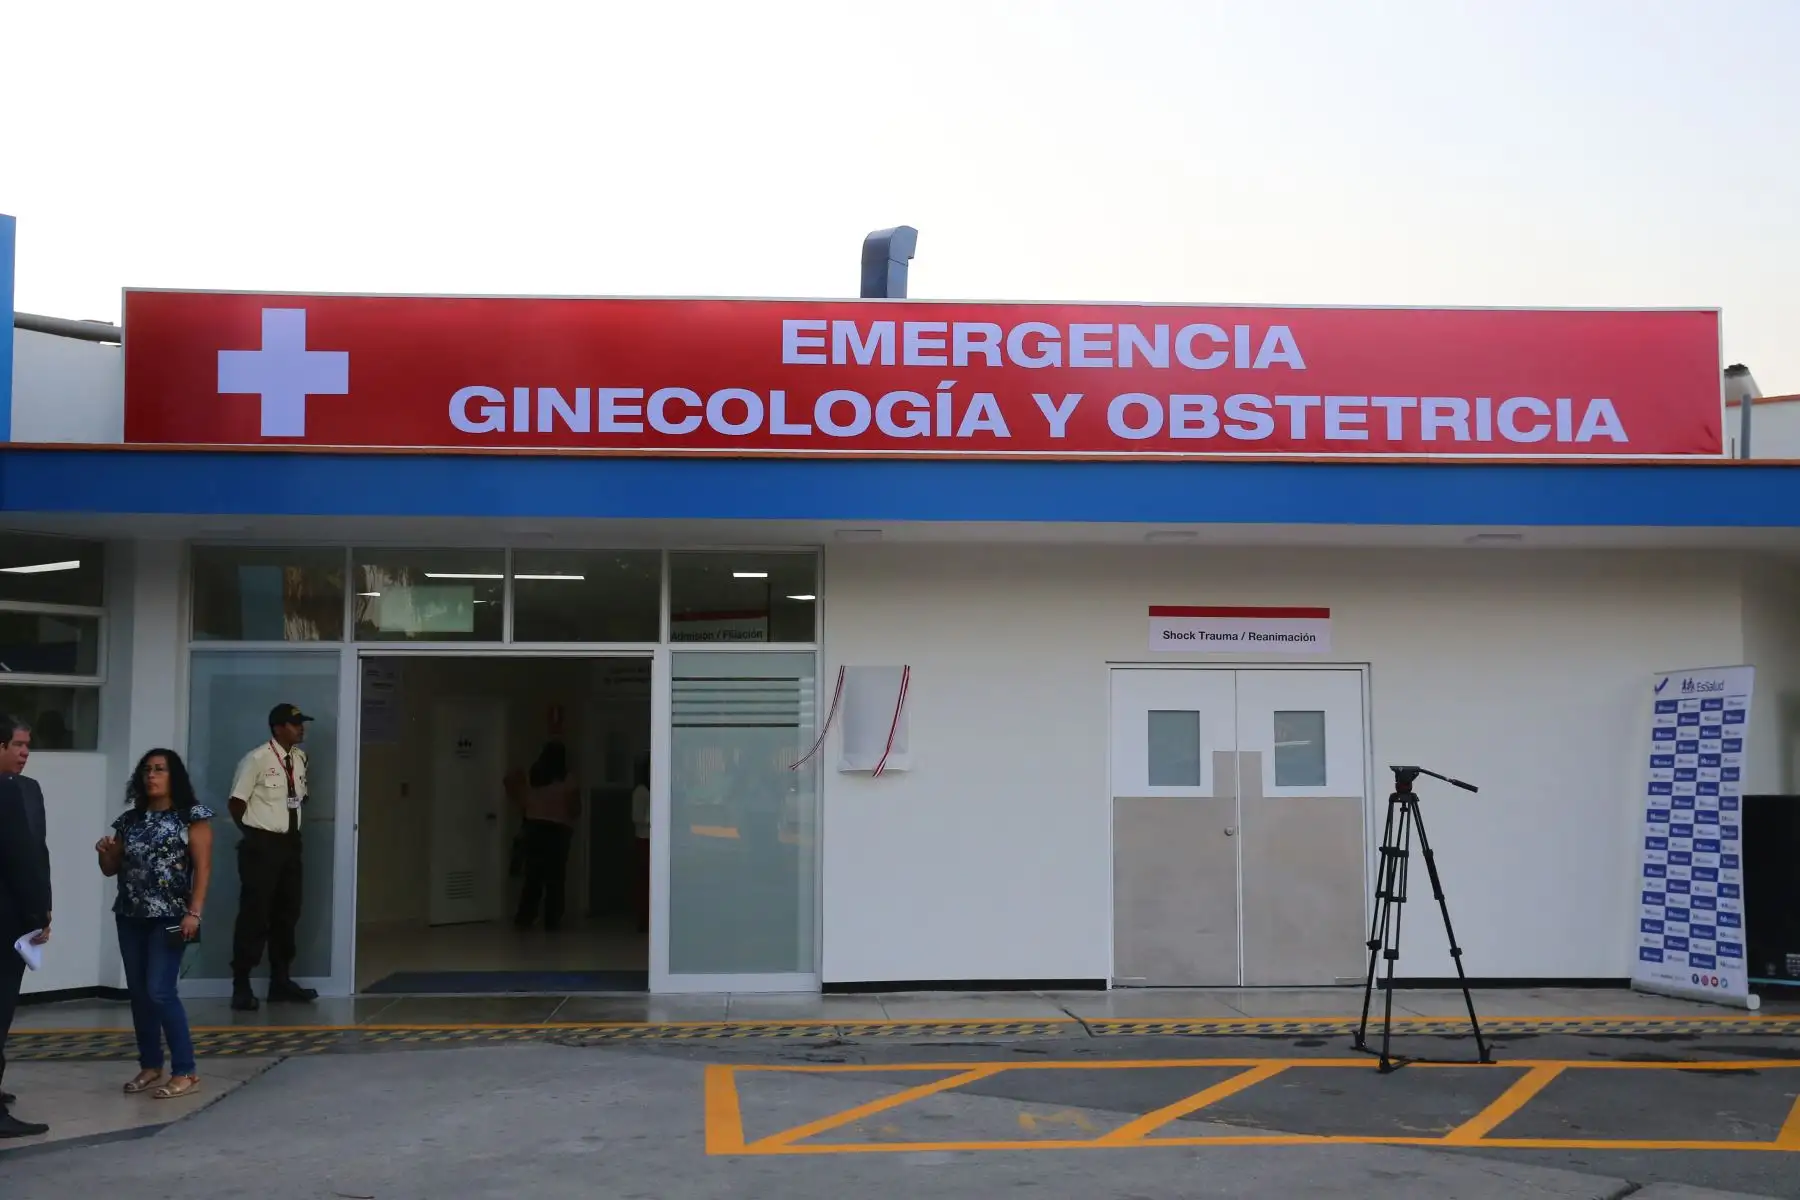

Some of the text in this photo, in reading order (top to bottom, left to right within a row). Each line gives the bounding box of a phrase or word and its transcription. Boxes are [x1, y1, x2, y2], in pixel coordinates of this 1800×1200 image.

[782, 319, 1306, 370] EMERGENCIA
[448, 381, 1629, 443] GINECOLOGÍA Y OBSTETRICIA
[1163, 630, 1196, 640] Shock
[1199, 631, 1239, 641] Trauma
[1248, 632, 1316, 642] Reanimación
[1696, 679, 1725, 692] EsSalud
